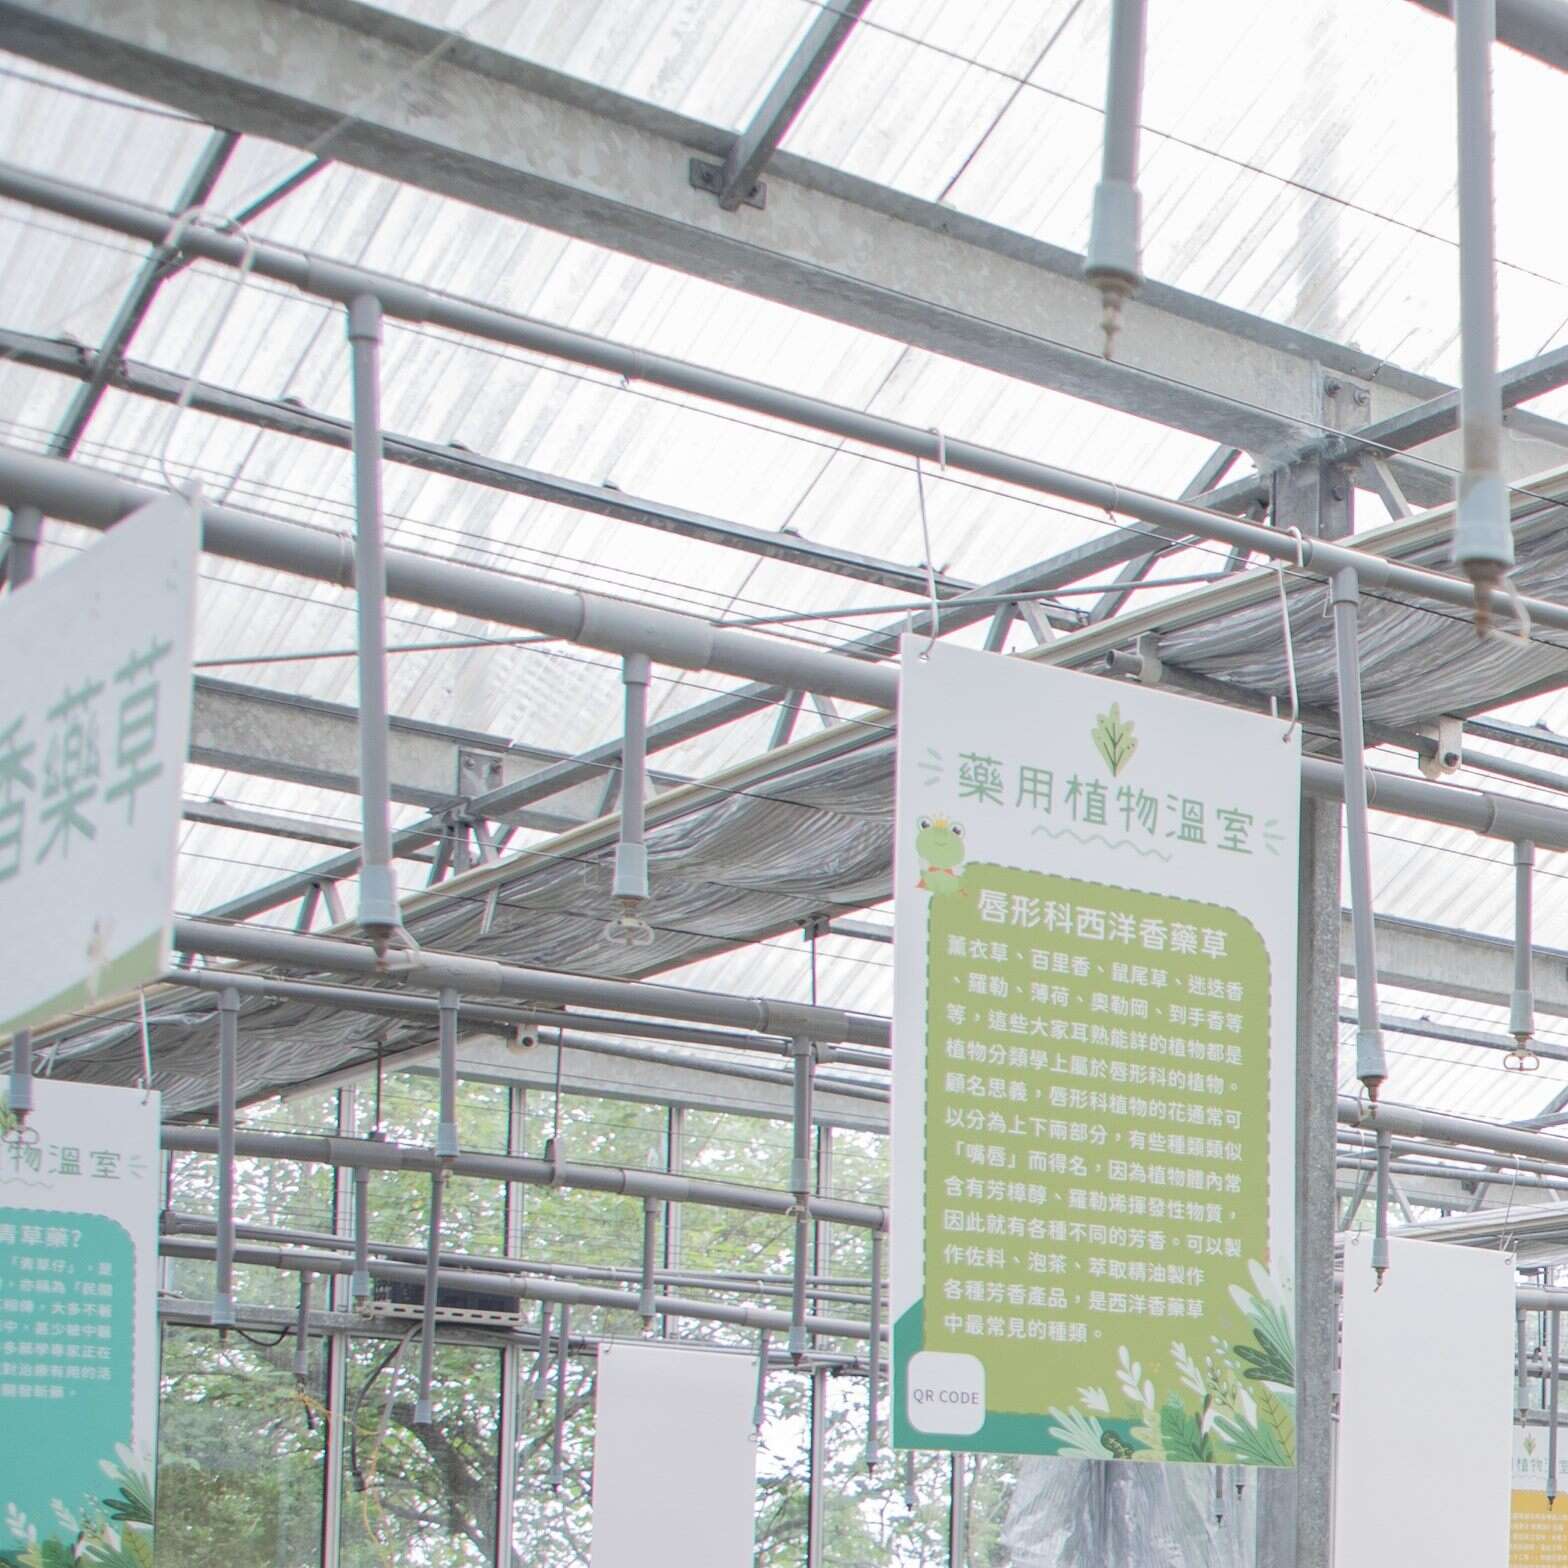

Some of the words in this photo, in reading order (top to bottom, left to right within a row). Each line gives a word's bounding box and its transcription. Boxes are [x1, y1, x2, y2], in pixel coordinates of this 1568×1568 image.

[957, 752, 1254, 855] 藥用植物溫室
[978, 889, 1229, 960] 唇形科西洋香藥草
[943, 1314, 1103, 1343] 中最常見的種類。
[912, 1388, 935, 1403] QR
[939, 1389, 980, 1405] CODE
